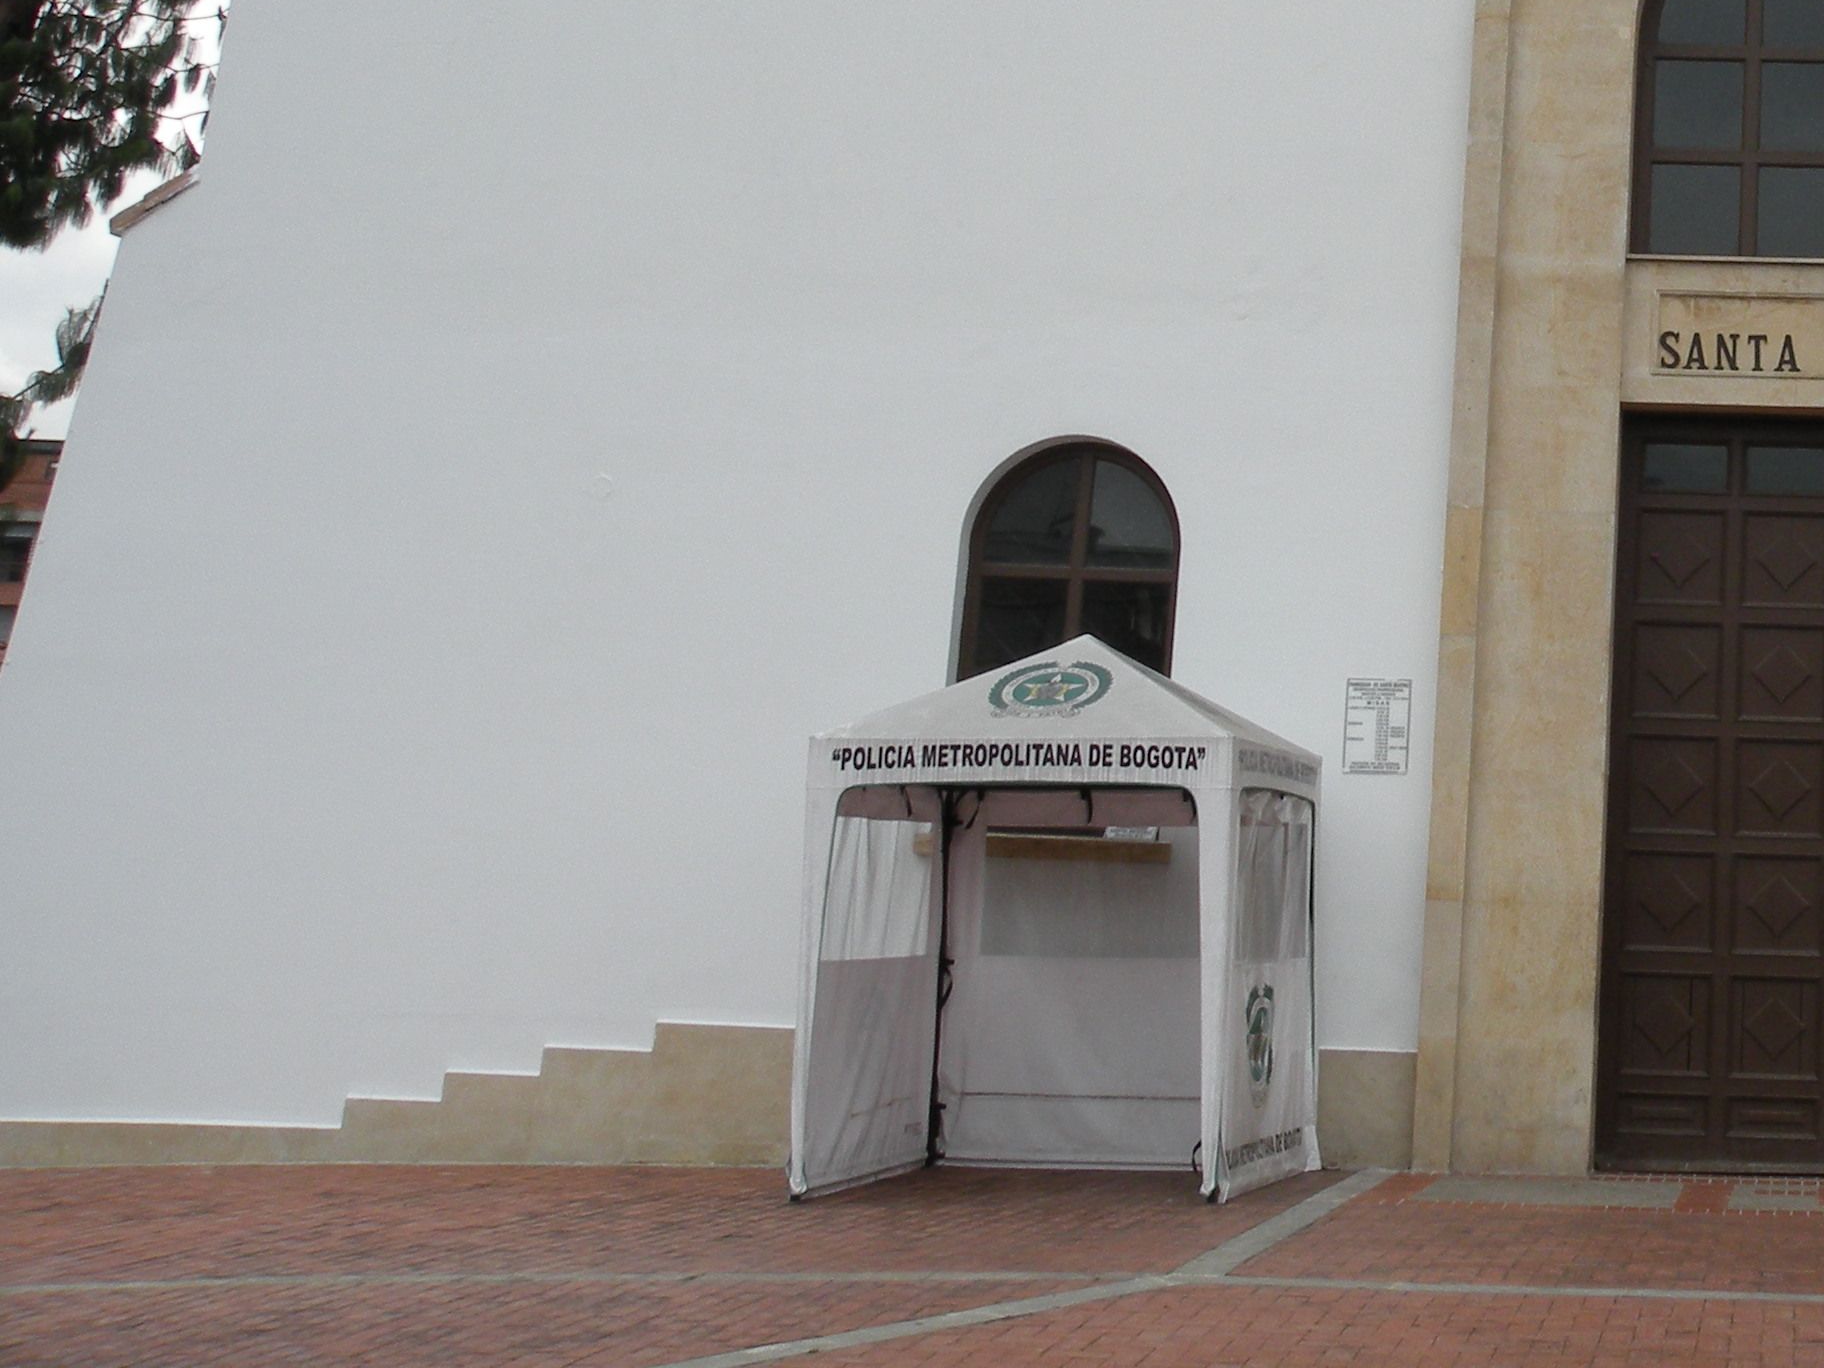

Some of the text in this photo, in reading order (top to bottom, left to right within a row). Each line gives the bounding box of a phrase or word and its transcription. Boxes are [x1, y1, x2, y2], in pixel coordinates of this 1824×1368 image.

[1658, 331, 1802, 372] SANTA
[921, 743, 1083, 769] METROPOLITANA
[1088, 743, 1114, 768] DE
